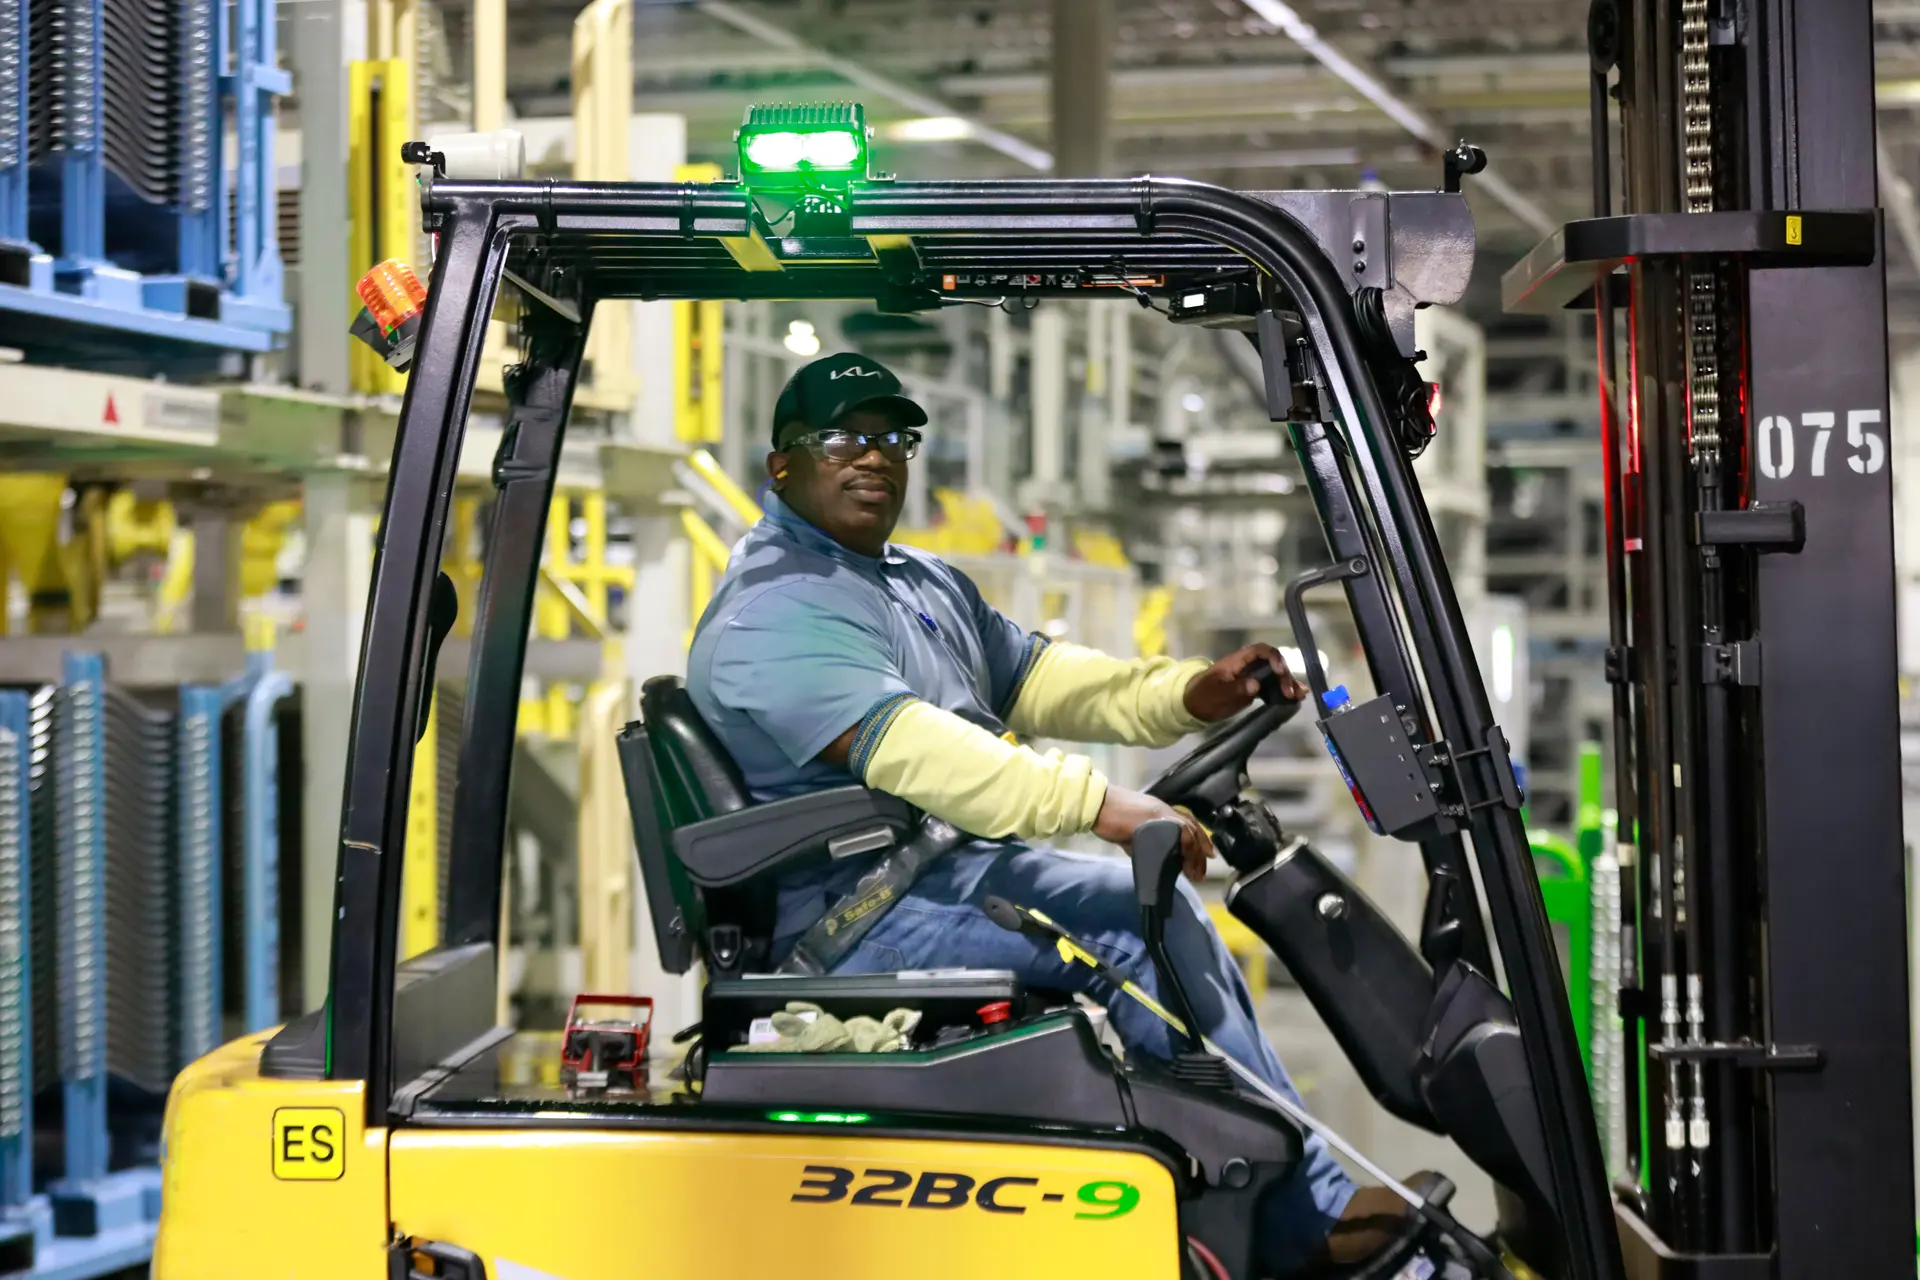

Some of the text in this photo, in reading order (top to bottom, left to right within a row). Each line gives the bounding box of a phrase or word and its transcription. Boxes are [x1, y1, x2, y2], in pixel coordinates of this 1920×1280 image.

[1758, 409, 1884, 479] 075
[283, 1124, 334, 1163] ES
[790, 1165, 1141, 1220] 32BC-9
